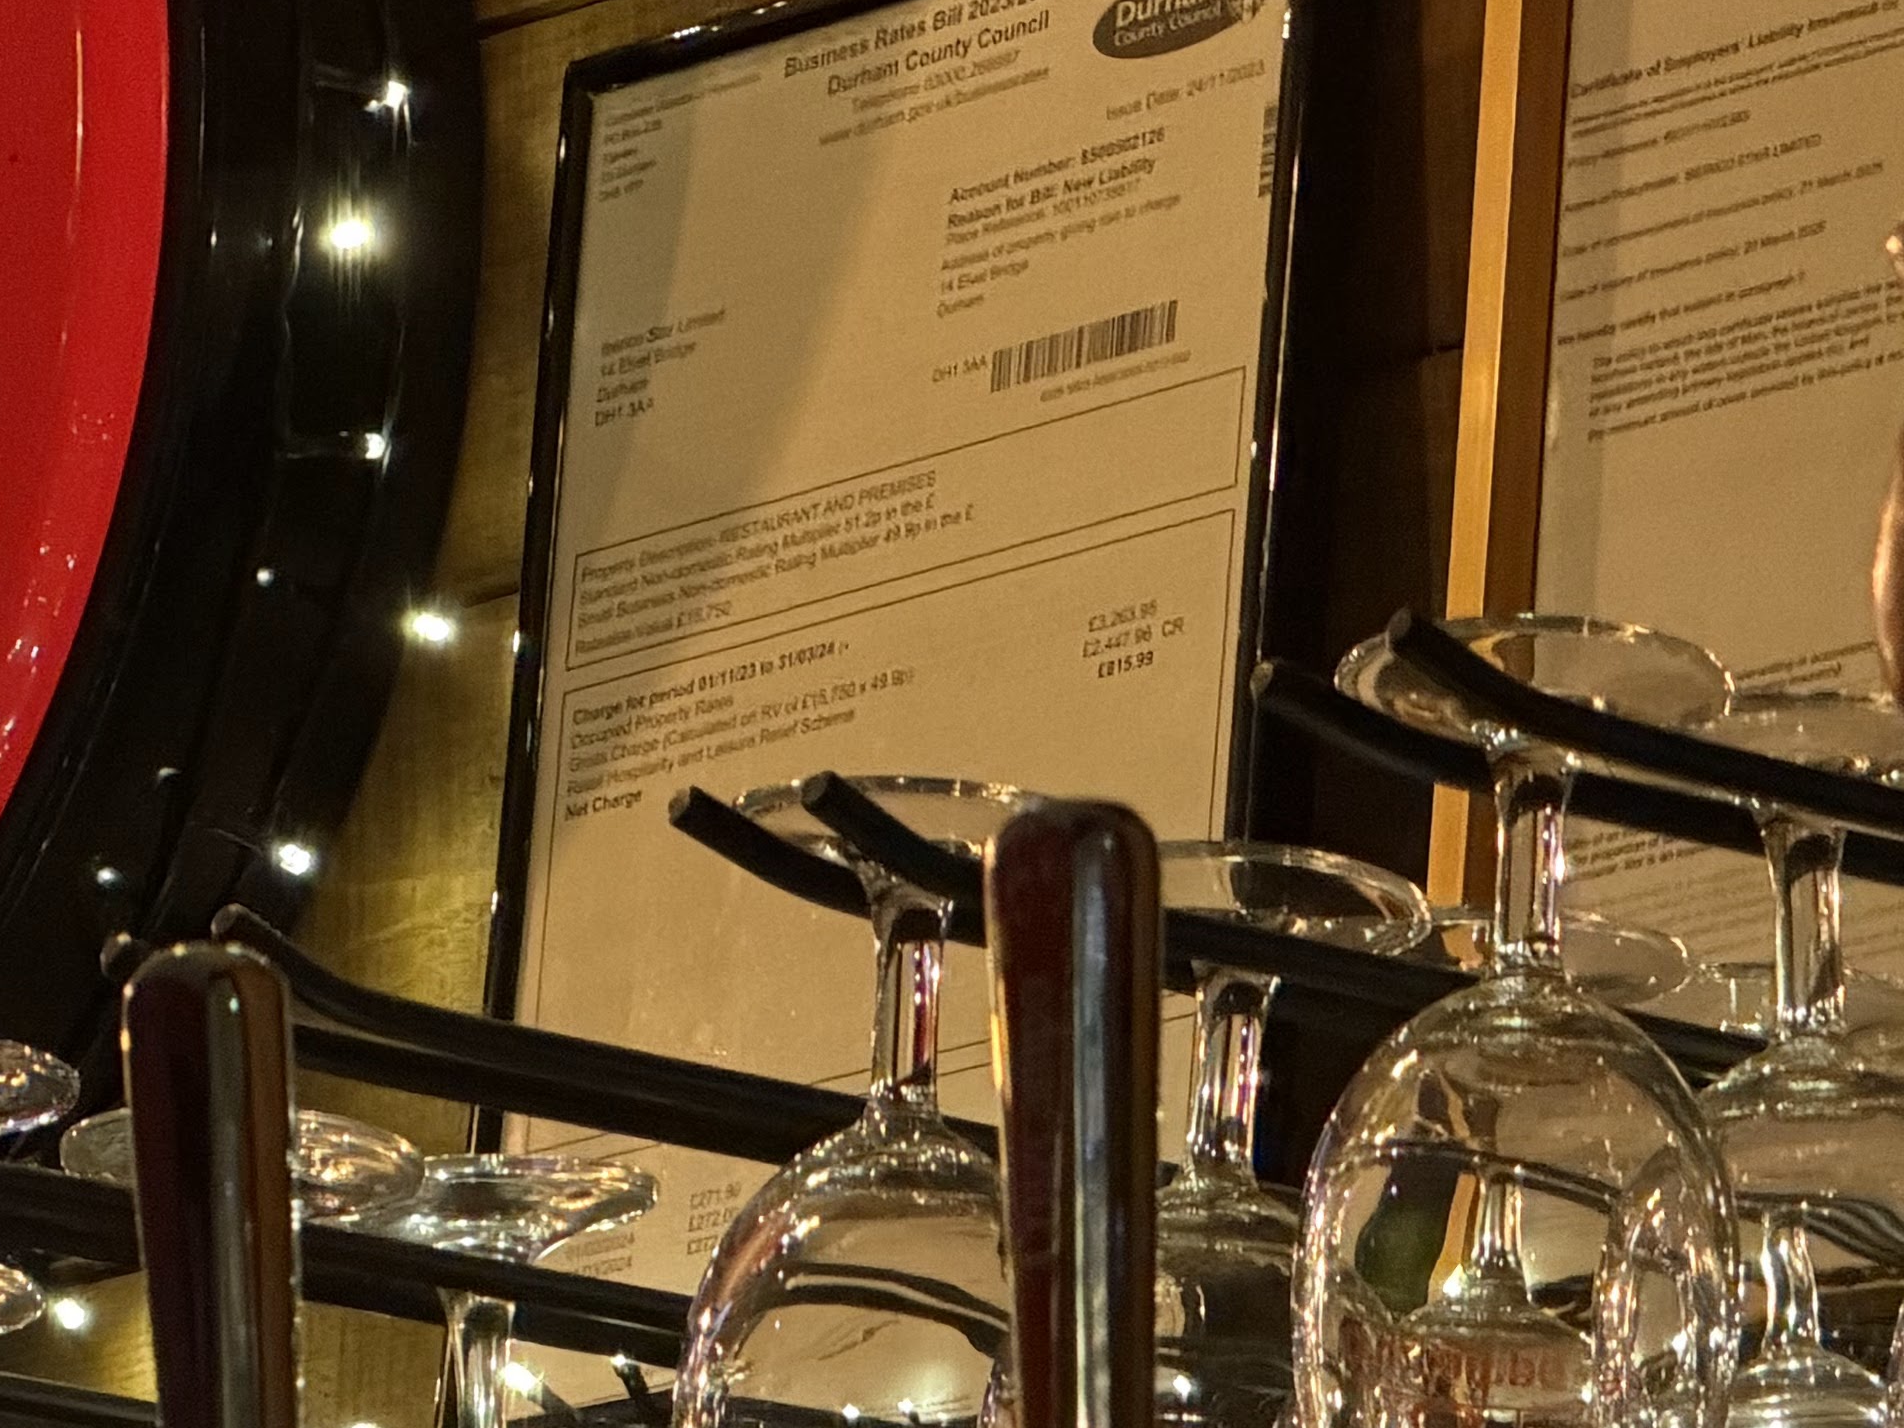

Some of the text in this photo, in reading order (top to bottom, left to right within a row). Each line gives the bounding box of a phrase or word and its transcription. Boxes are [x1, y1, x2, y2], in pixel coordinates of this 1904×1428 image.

[784, 37, 869, 78] Business
[874, 20, 926, 50] Rates
[932, 6, 963, 32] Bill
[1114, 0, 1221, 46] County Council
[827, 59, 900, 96] Durham
[905, 37, 972, 72] County
[978, 10, 1050, 49] Council
[1062, 176, 1095, 194] New
[823, 493, 855, 515] AND
[857, 469, 936, 506] PREMISES
[572, 701, 624, 726] Charge
[565, 789, 643, 821] Net Charge
